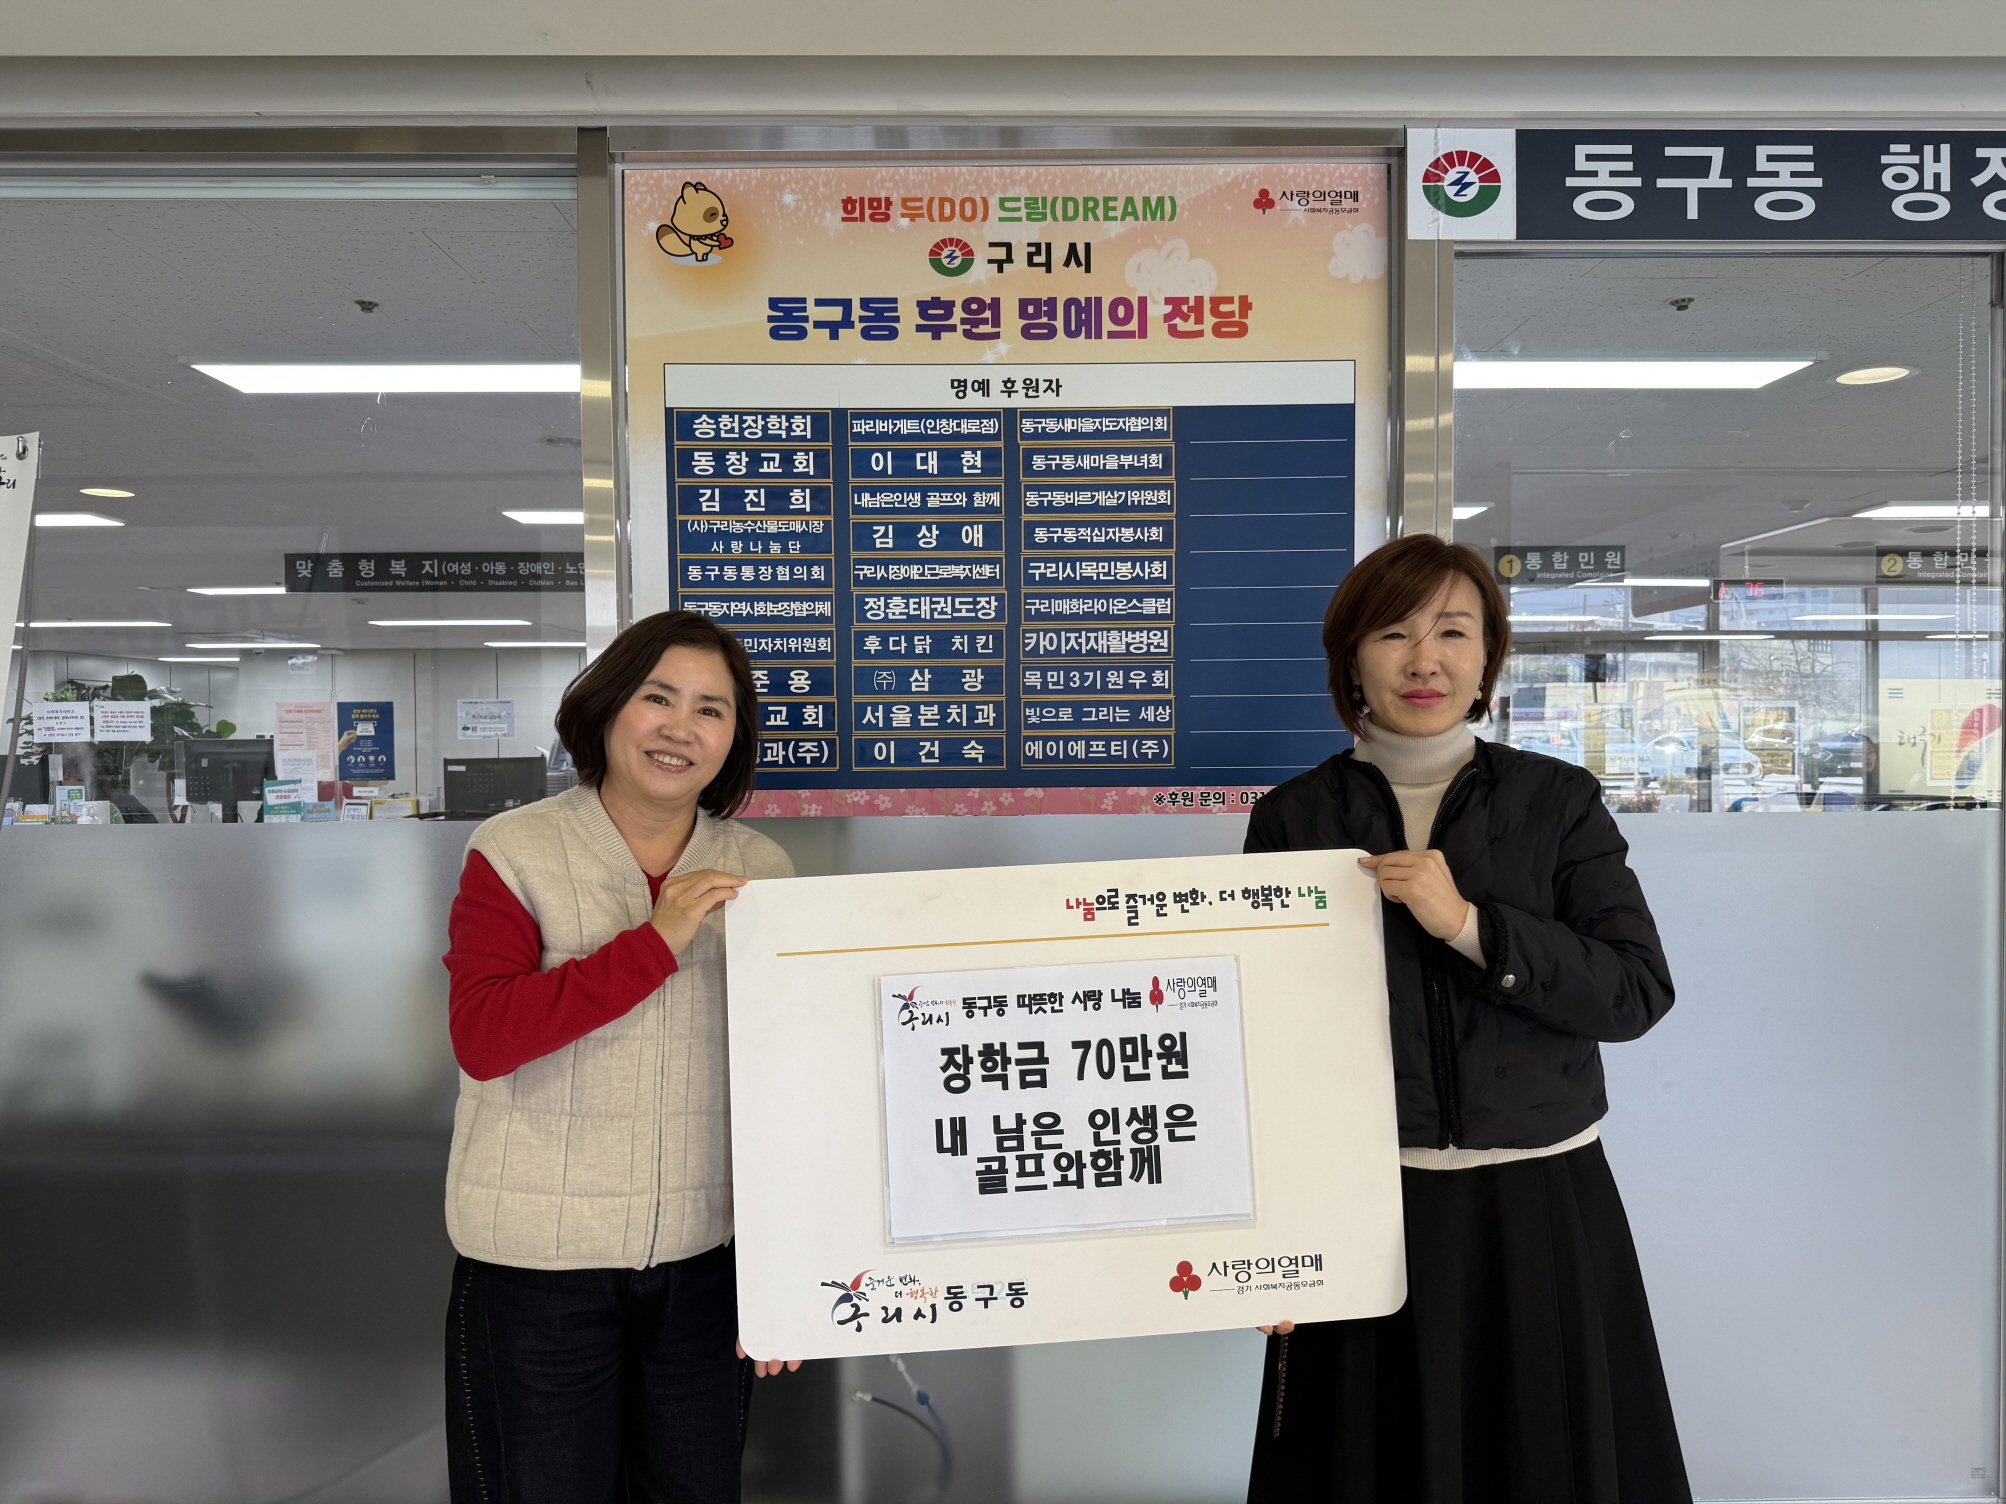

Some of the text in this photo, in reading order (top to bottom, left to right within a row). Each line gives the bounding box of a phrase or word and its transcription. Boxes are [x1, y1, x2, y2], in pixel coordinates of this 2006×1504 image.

[1565, 144, 1823, 222] 동구동
[1279, 190, 1359, 206] 사랑의열매
[841, 196, 1177, 223] 희망 두(DO) 드림(DREAM)
[987, 242, 1092, 274] 구리시
[767, 295, 1253, 341] 동구동 후원 명예의 전당
[950, 377, 1063, 399] 명예 후원자
[693, 414, 811, 439] 송헌장학회
[852, 418, 999, 434] 파리바게트(인창대로점)
[1020, 416, 1168, 433] 동구동새마을지도자협의회
[691, 451, 815, 476] 동창교회
[1031, 453, 1163, 471] 동구동새마을부녀회
[854, 492, 1000, 508] 내남은인생 골프와 함께
[1025, 489, 1171, 507] 동구동바르게살기위원회
[687, 519, 824, 534] (사)구리농수산물도매시장
[1033, 527, 1163, 543] 동구동적십자봉사회
[1028, 560, 1167, 581] 구리시목민봉사회
[1525, 551, 1621, 570] 통합민원
[1887, 551, 1989, 573] 2 통합민
[687, 565, 826, 582] 동구동통장협의회
[1537, 571, 1574, 579] Integrated
[863, 596, 998, 620] 정훈태권도장
[1025, 598, 1171, 616] 구리매화라이온스클럽
[737, 637, 831, 653] 민자치위원회
[1024, 630, 1168, 654] 카이저재활병원
[1023, 670, 1170, 690] 목민3기원우회
[861, 704, 996, 727] 서울본치과
[1025, 705, 1171, 724] 빛으로 그리는 세상
[756, 741, 829, 764] 과(주)
[1025, 739, 1169, 760] 에이에프티(주)
[1199, 791, 1226, 807] 문의
[1066, 885, 1327, 926] 나눔으로 즐거운 변화, 더 행복한 나눔
[1166, 976, 1217, 1000] 사랑의열매
[962, 988, 1142, 1019] 동구동 따뜻한 사랑 나눔
[901, 1009, 950, 1031] 구리시
[939, 1031, 1189, 1094] 장학금 70만원
[935, 1103, 1197, 1157] 내 남은 인생은
[975, 1145, 1162, 1195] 골프와함께
[1207, 1253, 1323, 1283] 사랑의열매
[865, 1275, 895, 1290] 즐거운
[1254, 1279, 1324, 1291] 사회복지공동모금회
[895, 1286, 940, 1303] 더 행복한
[837, 1303, 937, 1334] 구리시
[944, 1281, 1029, 1313] 동구동
